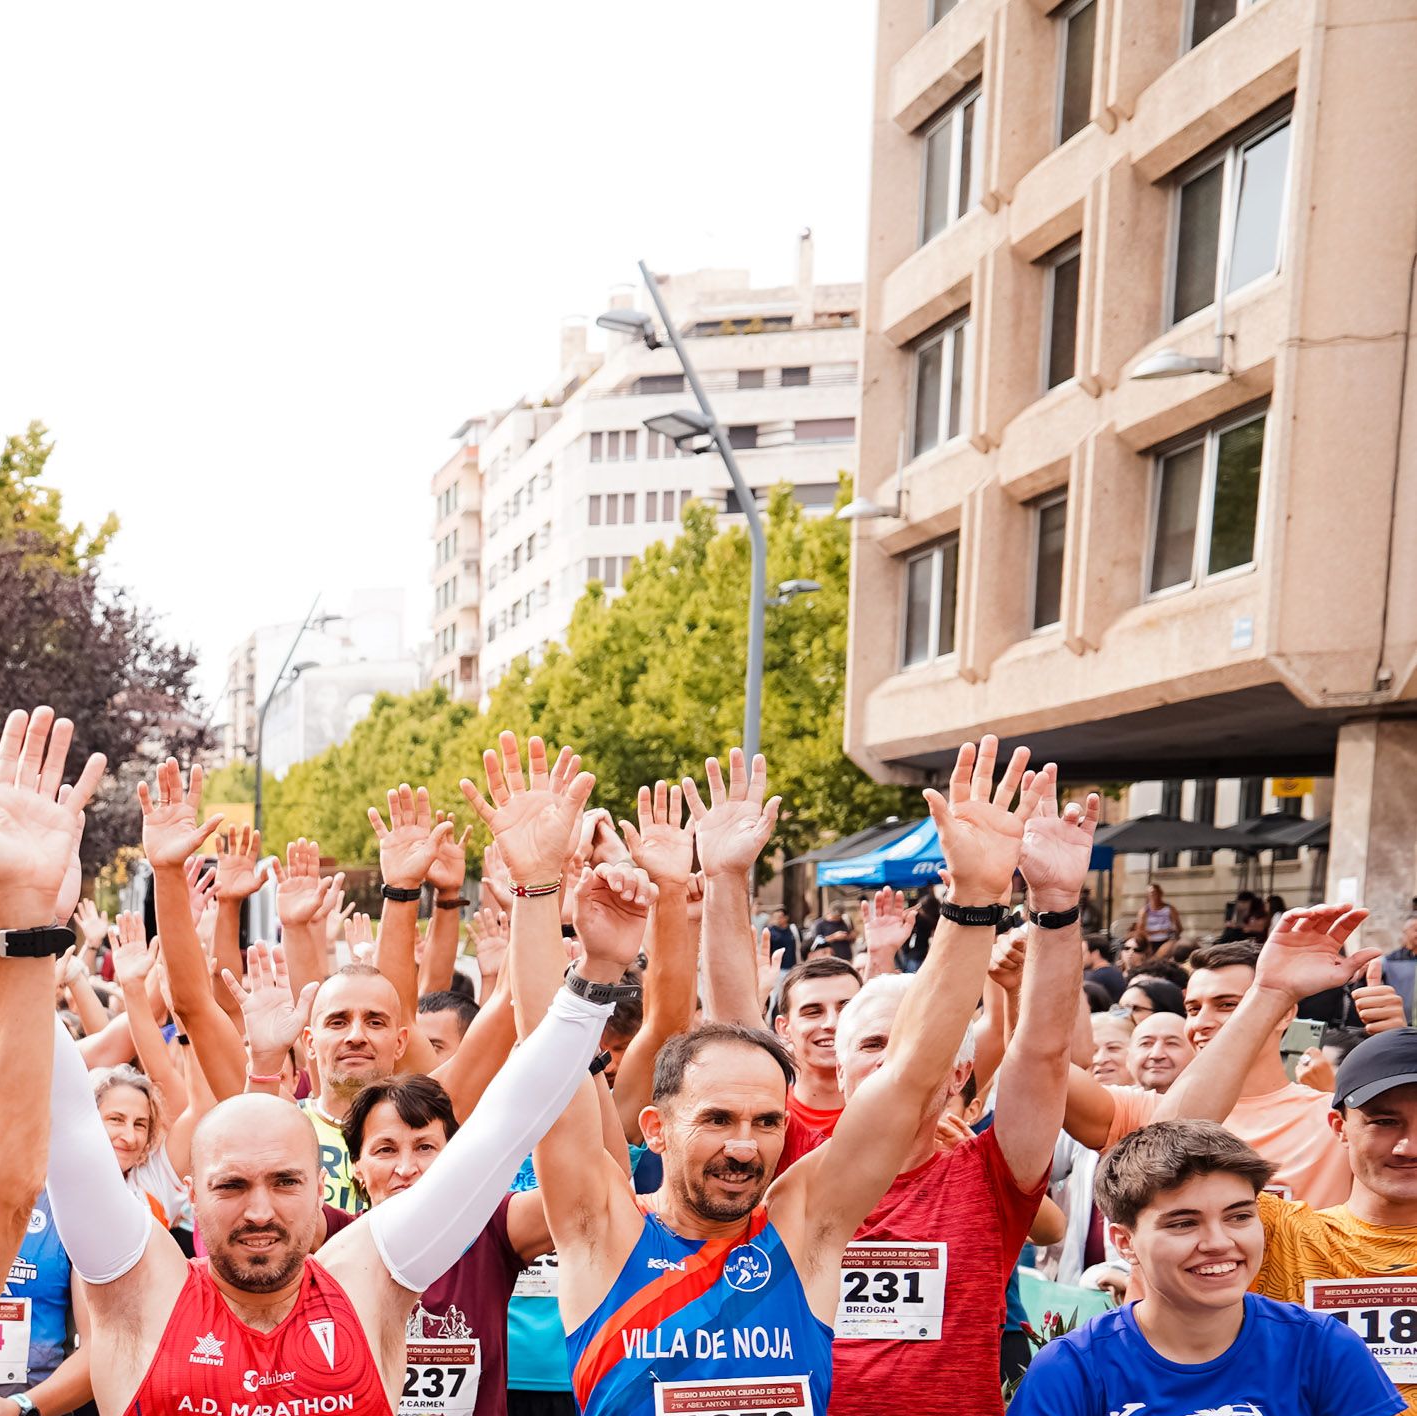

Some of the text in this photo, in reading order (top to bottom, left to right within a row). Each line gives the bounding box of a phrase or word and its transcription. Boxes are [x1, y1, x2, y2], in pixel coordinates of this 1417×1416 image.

[622, 1327, 794, 1360] VILLA DE NOJA
[189, 1354, 223, 1366] luanvi
[699, 1389, 736, 1398] MARATÓN
[178, 1395, 222, 1416] A.D.
